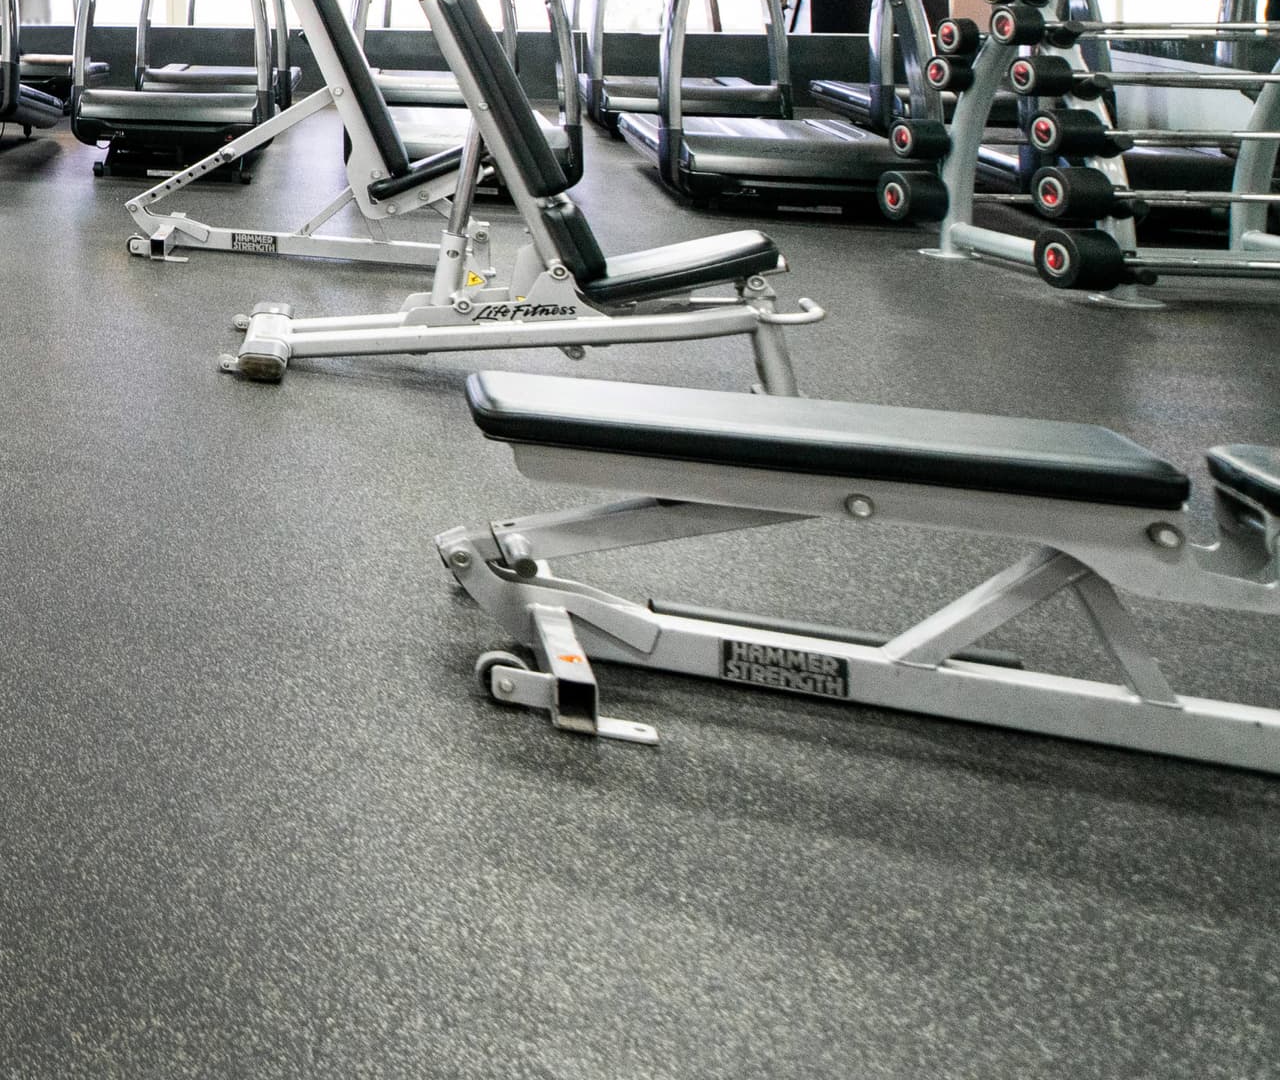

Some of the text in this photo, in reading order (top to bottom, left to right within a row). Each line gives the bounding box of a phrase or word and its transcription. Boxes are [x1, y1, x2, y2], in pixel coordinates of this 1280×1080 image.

[232, 241, 276, 253] STRENGTH
[235, 232, 273, 244] HAMMER
[472, 303, 577, 322] Life Fitness
[731, 640, 840, 677] HAMMER
[725, 659, 844, 697] STRENGTH
